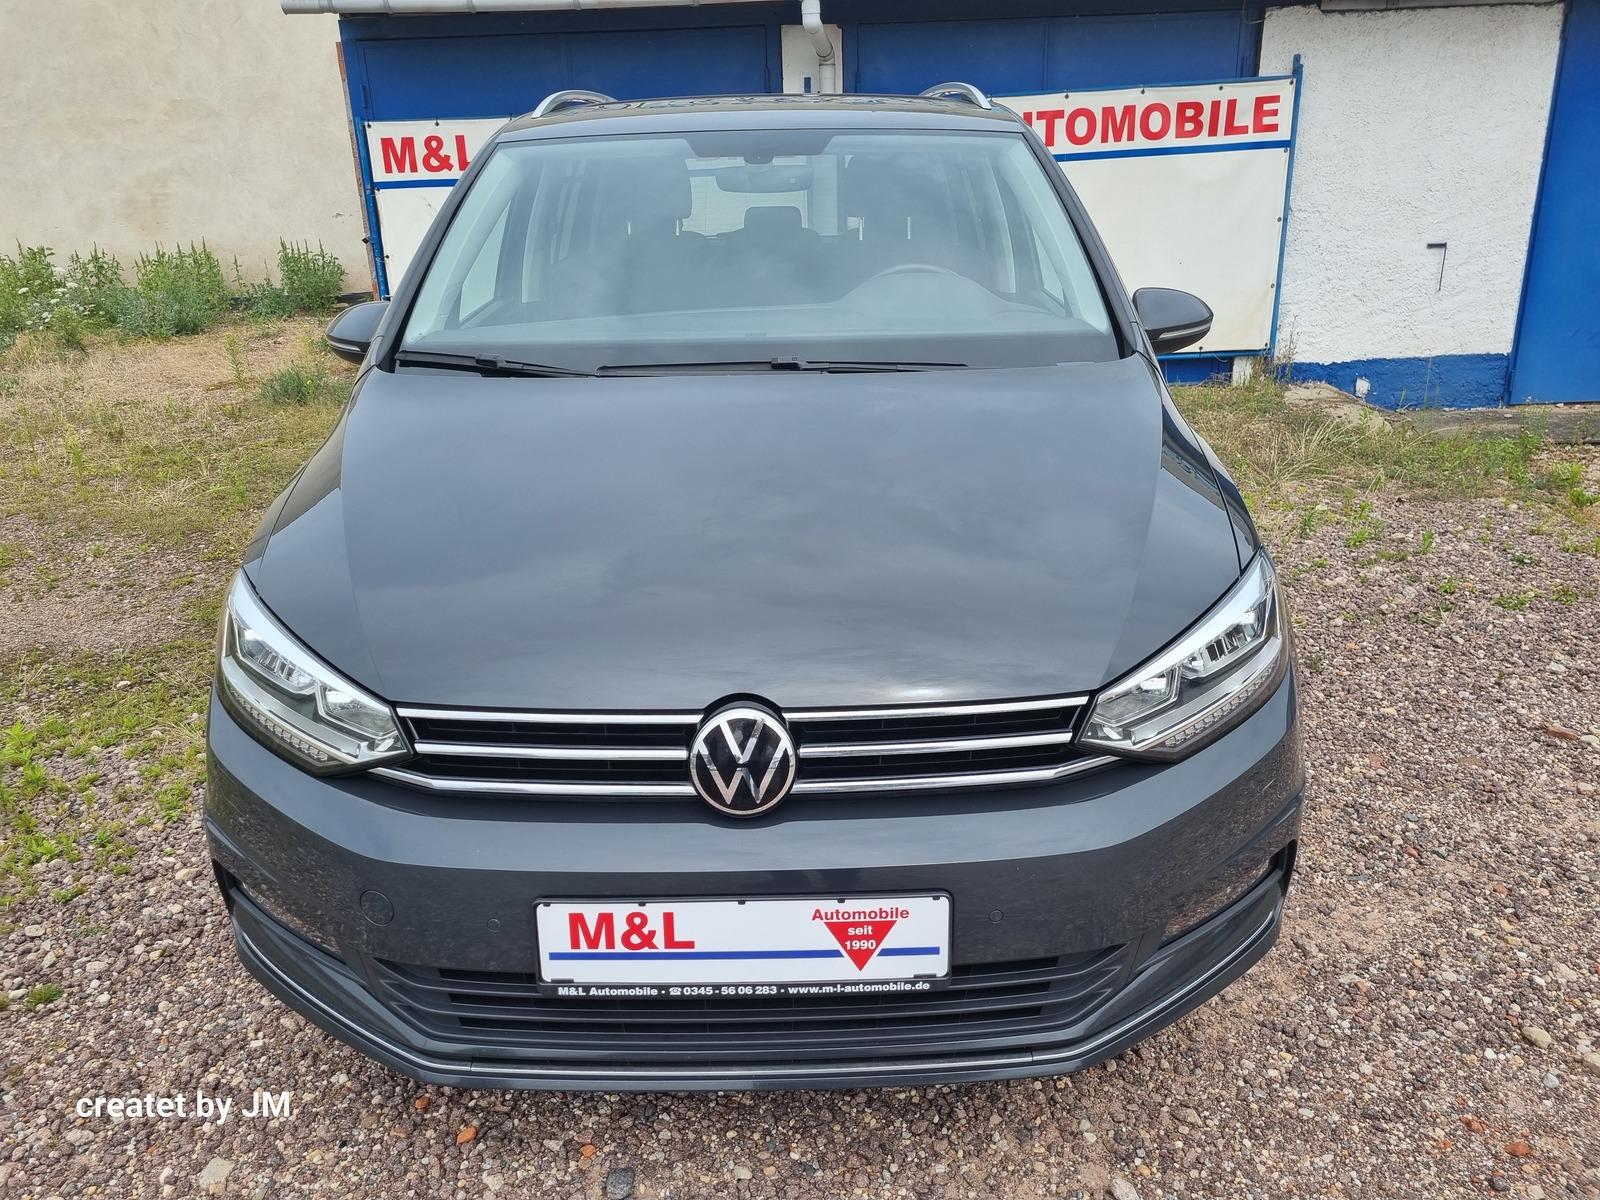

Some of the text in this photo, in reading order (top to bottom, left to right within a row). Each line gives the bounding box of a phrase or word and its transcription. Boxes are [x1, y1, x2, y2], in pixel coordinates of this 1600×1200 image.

[1022, 94, 1281, 147] TOMOBILE
[811, 907, 910, 921] Automobile
[568, 911, 696, 951] M&L
[847, 925, 873, 935] seit
[844, 939, 876, 950] 1990
[557, 986, 586, 996] M&L
[589, 986, 658, 996] Automobile
[788, 981, 931, 994] www.m-l-automobile.de
